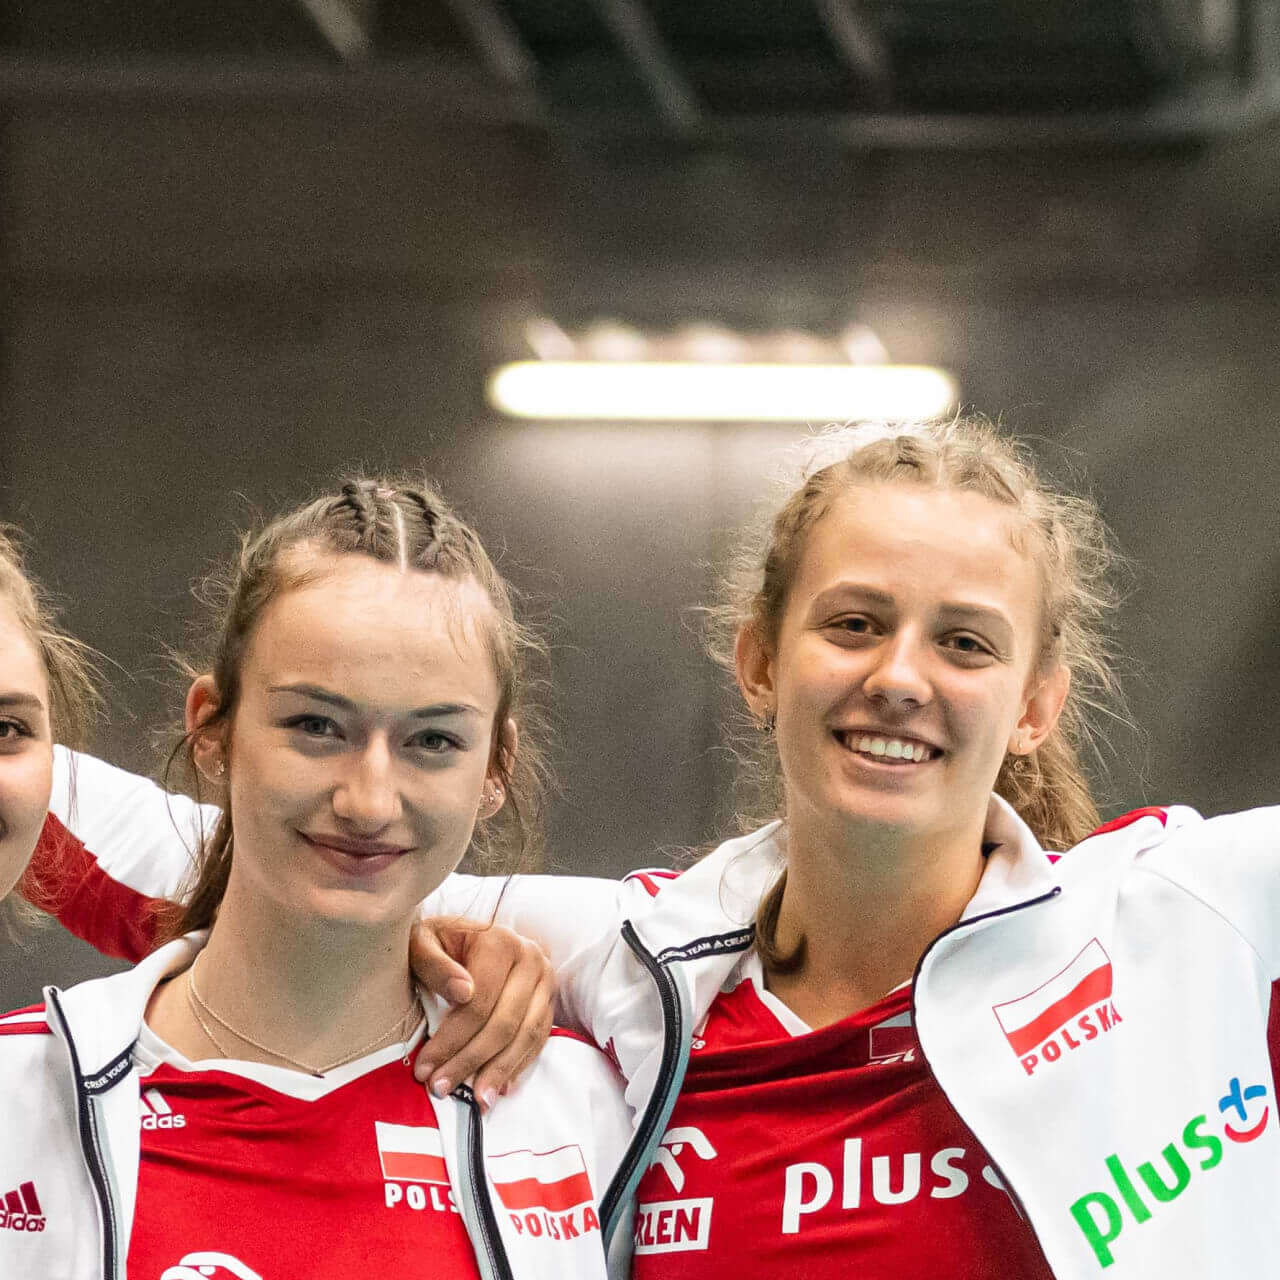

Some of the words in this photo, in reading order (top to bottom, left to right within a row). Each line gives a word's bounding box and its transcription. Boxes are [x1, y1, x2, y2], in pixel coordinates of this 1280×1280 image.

[1020, 1000, 1123, 1076] POLSKA
[141, 1112, 187, 1130] das
[781, 1137, 969, 1234] plus
[1069, 1113, 1223, 1269] plus
[509, 1206, 601, 1241] POLSKA
[634, 1206, 702, 1247] RLEN
